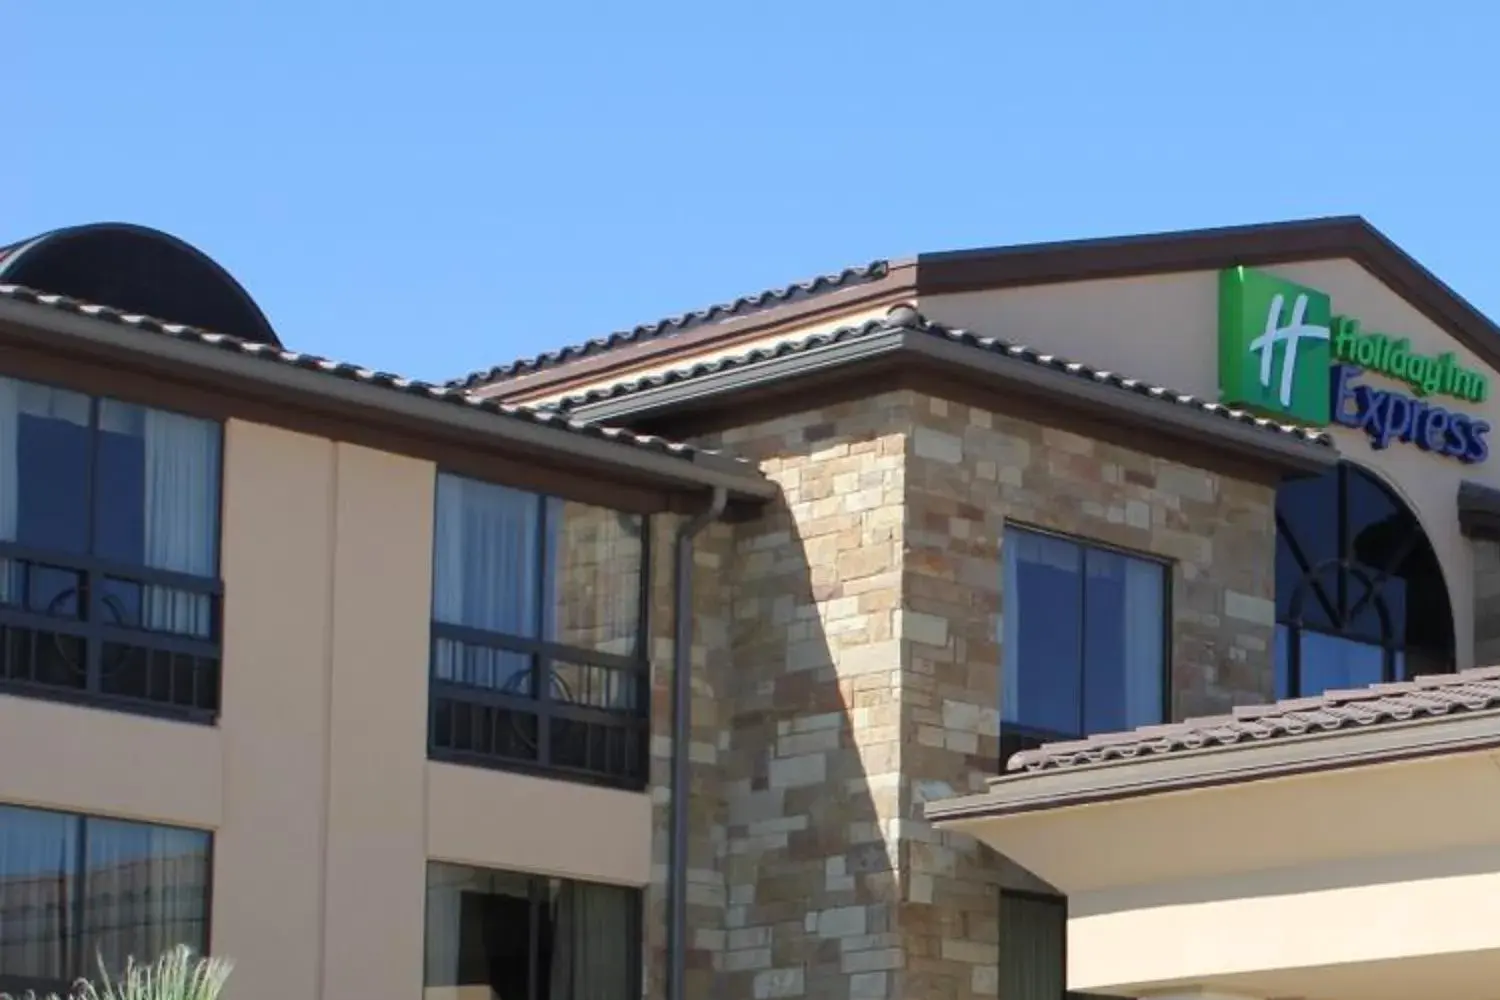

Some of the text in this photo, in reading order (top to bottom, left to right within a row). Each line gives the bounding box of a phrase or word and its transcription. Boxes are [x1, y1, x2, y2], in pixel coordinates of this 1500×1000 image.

[1250, 293, 1331, 407] H
[1333, 316, 1488, 403] Holiday Inn
[1331, 364, 1491, 463] Express
